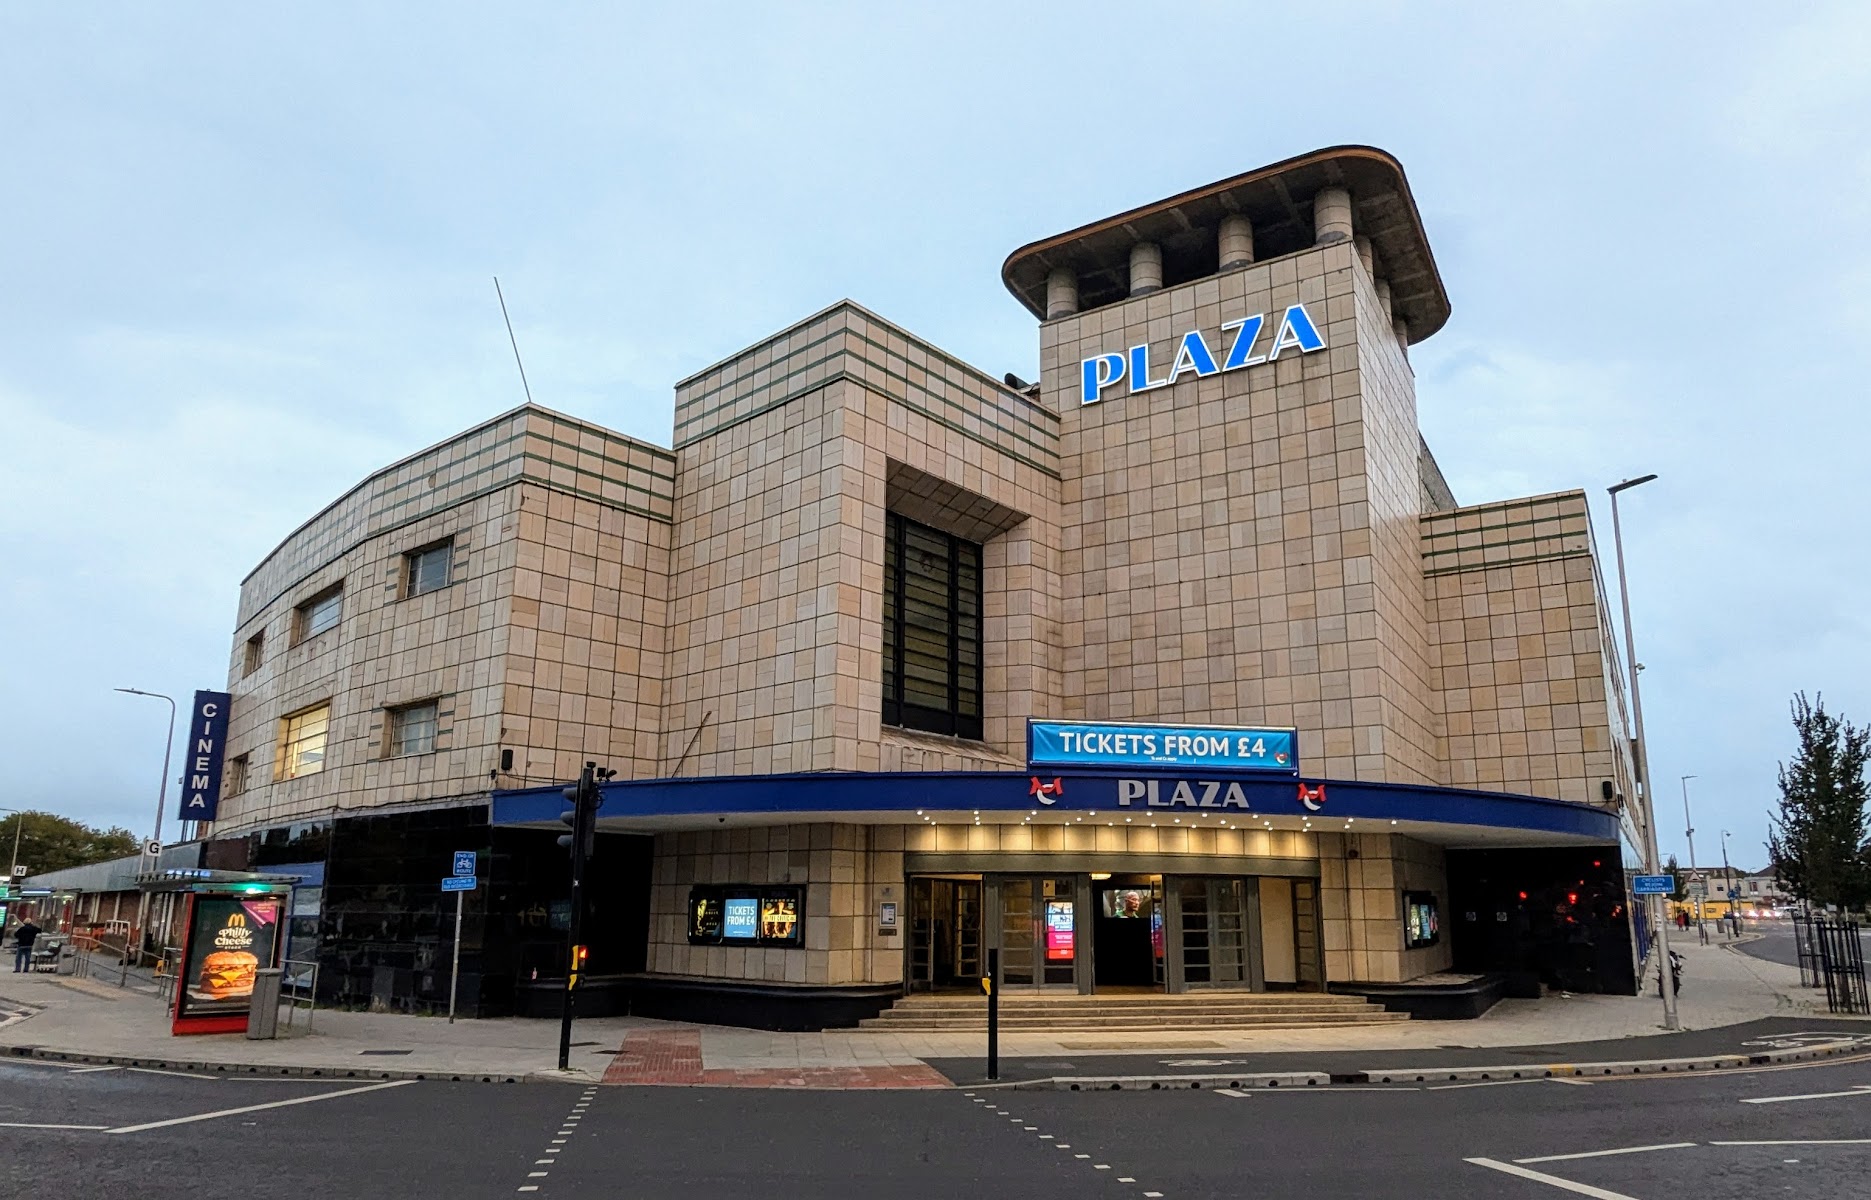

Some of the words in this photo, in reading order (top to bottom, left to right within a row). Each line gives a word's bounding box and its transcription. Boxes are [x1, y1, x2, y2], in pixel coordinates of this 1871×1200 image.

[1081, 303, 1327, 406] PLAZA
[1059, 732, 1157, 756] TICKETS
[1165, 735, 1229, 757] FROM
[1237, 737, 1267, 758] £4
[188, 703, 218, 808] CINEMA
[1118, 779, 1250, 809] PLAZA
[149, 842, 160, 854] G
[16, 867, 24, 875] H
[728, 906, 755, 915] TICKETS
[727, 915, 745, 926] FROM
[746, 915, 755, 926] £4
[218, 927, 253, 938] Philly
[214, 937, 253, 946] Cheese
